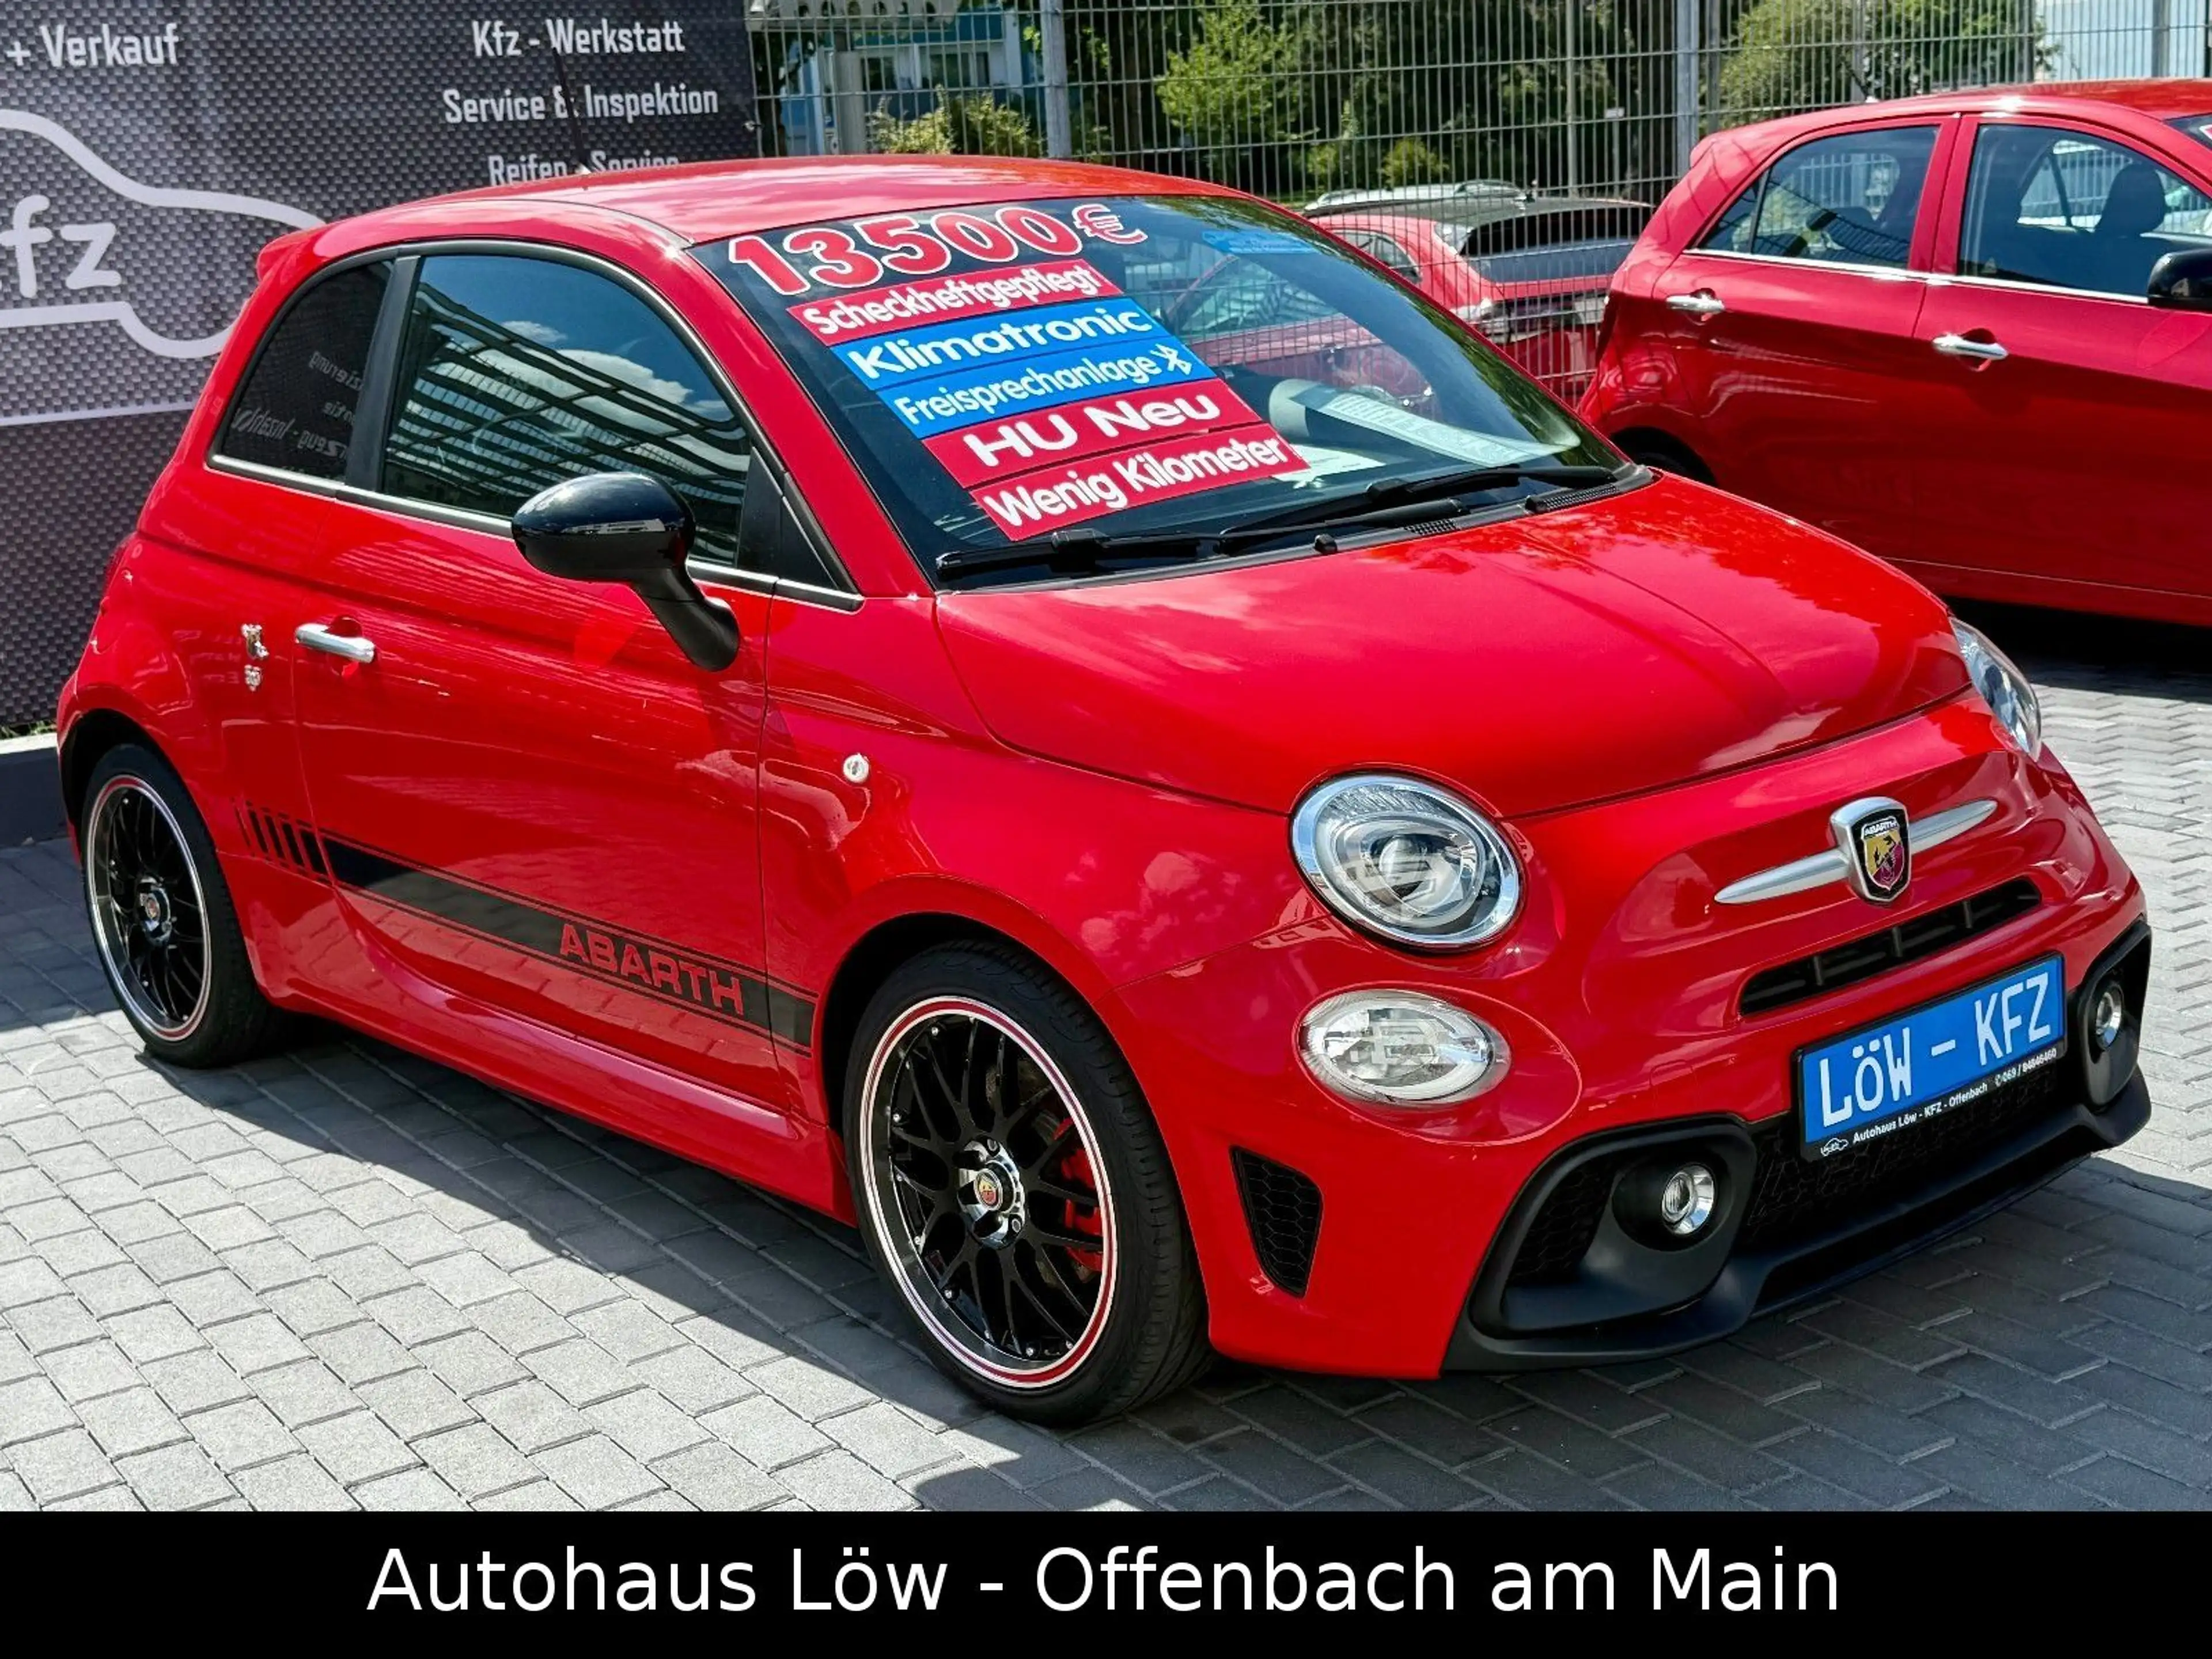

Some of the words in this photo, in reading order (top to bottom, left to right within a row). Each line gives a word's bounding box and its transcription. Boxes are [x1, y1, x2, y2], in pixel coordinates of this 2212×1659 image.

[39, 22, 179, 67] Verkauf
[472, 21, 522, 57] Kfz
[545, 18, 686, 55] Werkstatt
[442, 88, 546, 124] Service
[584, 82, 719, 123] Inspektion
[0, 194, 123, 298] fz
[802, 265, 1101, 335] Scheckheftgepflegt
[847, 308, 1152, 380] Klimatronic
[893, 351, 1157, 426] Freisprechanlage
[963, 414, 1078, 468] HU
[1085, 394, 1220, 438] Neu
[983, 469, 1121, 528] Wenig
[1113, 435, 1289, 489] Kilometer
[559, 923, 744, 1016] ABARTH
[1819, 1027, 1912, 1128] LÖW
[1931, 1039, 1956, 1056] -
[1975, 972, 2051, 1066] KFZ
[1853, 1120, 1896, 1144] Autohaus
[1898, 1111, 1917, 1128] Löw
[1924, 1101, 1942, 1118] KFZ
[1949, 1082, 1988, 1108] Offenbach
